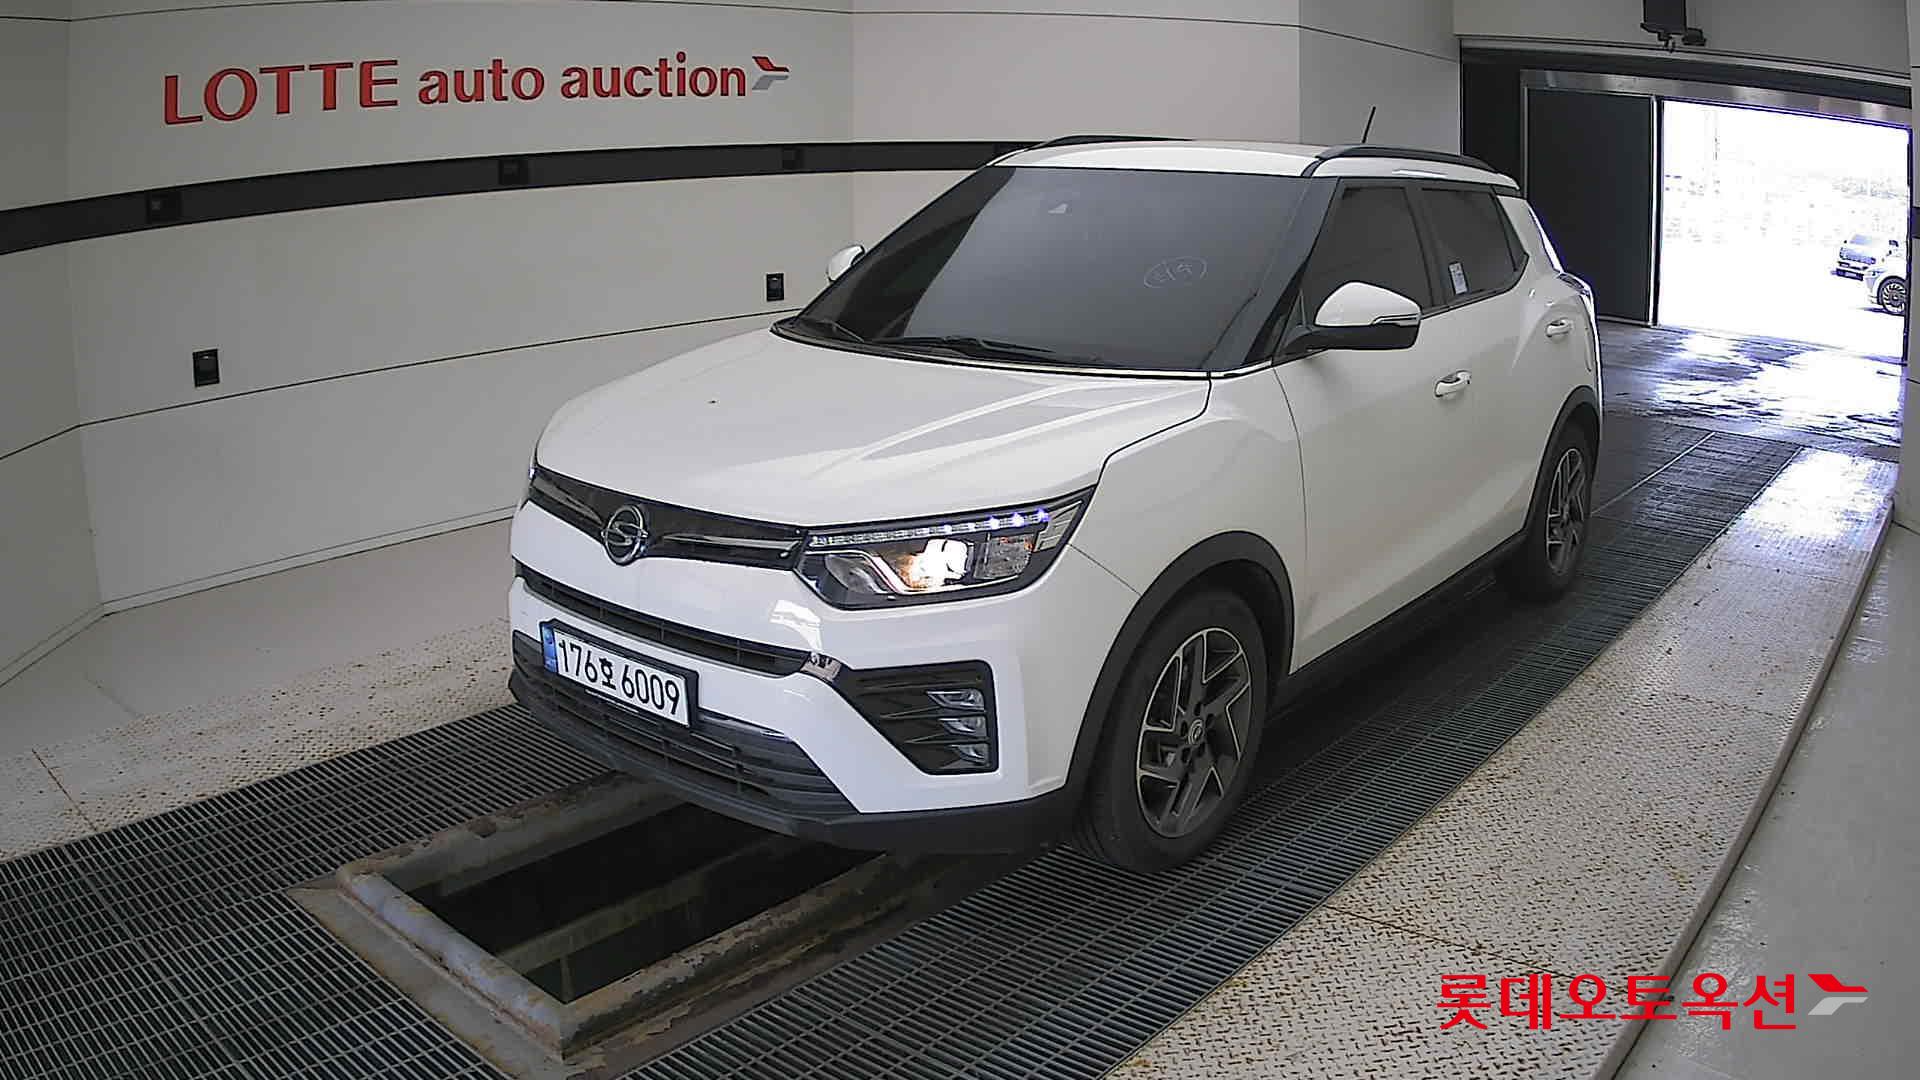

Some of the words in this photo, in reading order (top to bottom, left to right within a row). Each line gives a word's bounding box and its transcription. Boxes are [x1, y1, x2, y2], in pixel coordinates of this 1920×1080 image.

[164, 58, 399, 126] LOTTE
[418, 58, 546, 104] auto
[561, 51, 747, 98] auction
[621, 664, 680, 715] 6009
